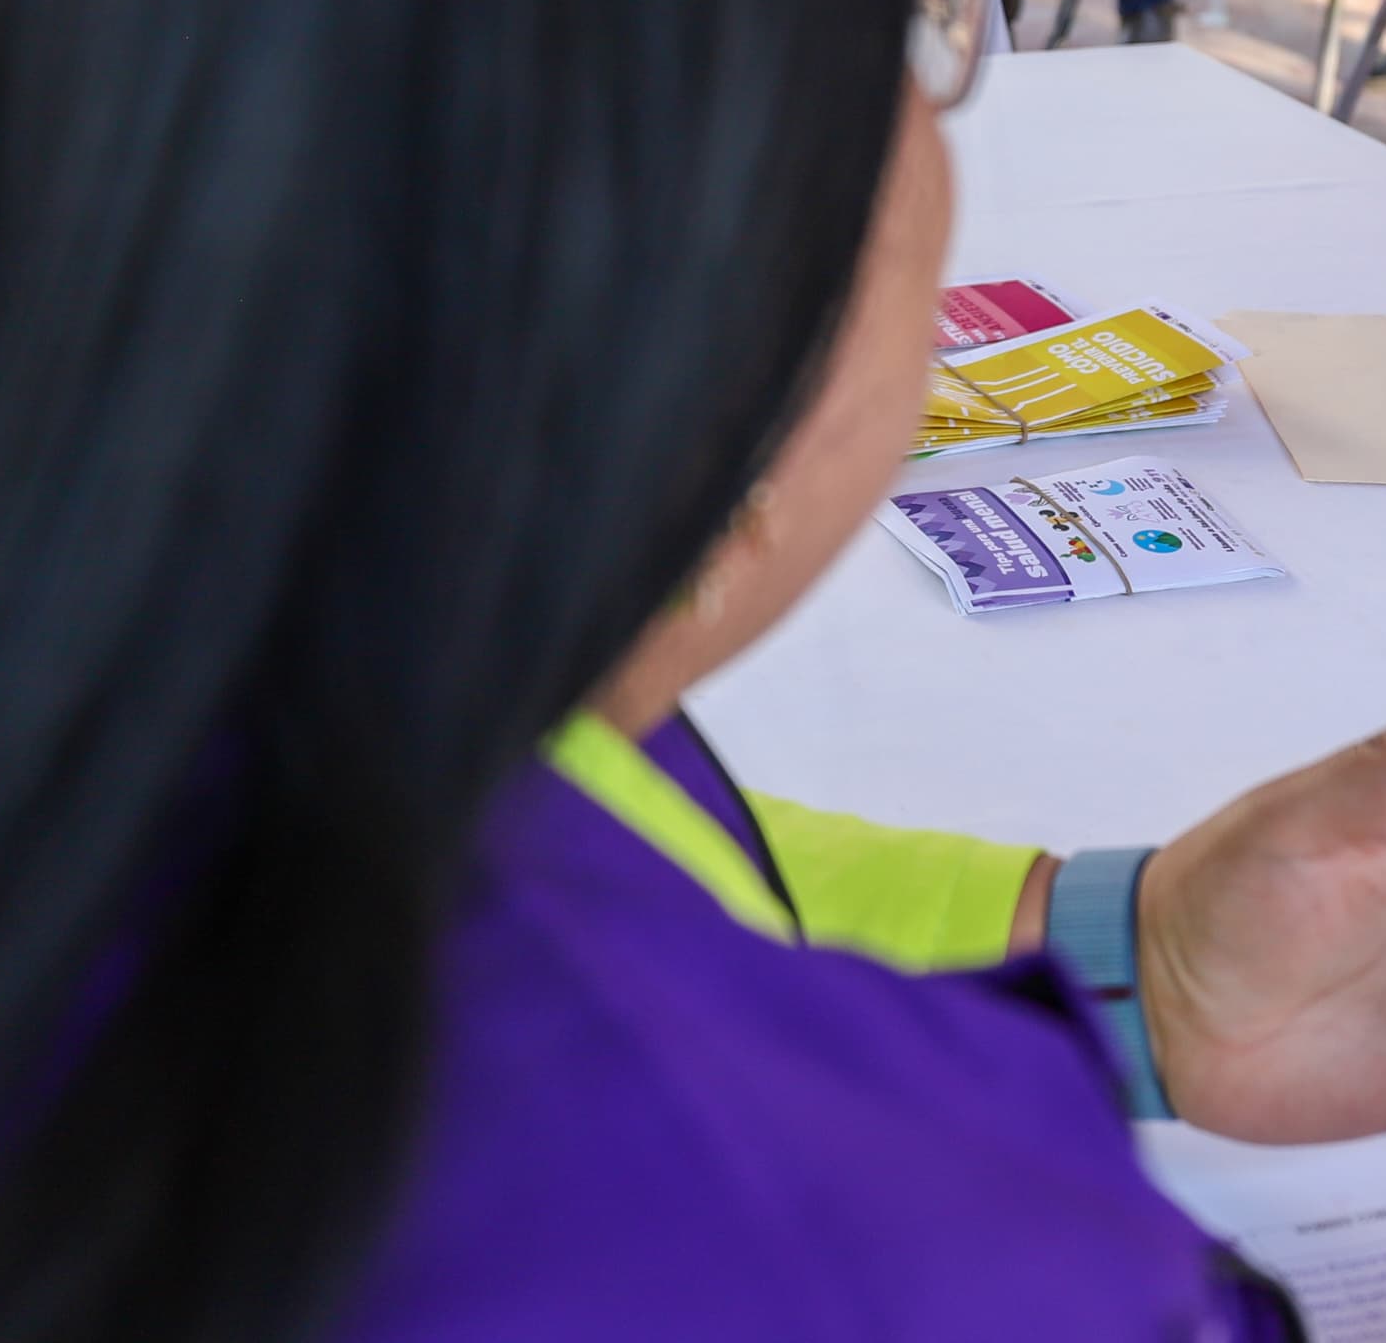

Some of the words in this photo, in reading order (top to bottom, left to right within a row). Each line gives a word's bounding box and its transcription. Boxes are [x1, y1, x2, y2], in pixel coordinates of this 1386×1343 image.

[1069, 336, 1092, 349] EL
[1047, 343, 1101, 374] CÓMO
[1084, 346, 1145, 385] PREVENIR
[1092, 331, 1177, 382] SUICIDIO
[938, 498, 968, 520] buena
[961, 519, 982, 533] una
[976, 533, 1003, 551] para
[989, 529, 1048, 578] salud
[993, 552, 1016, 575] Tips
